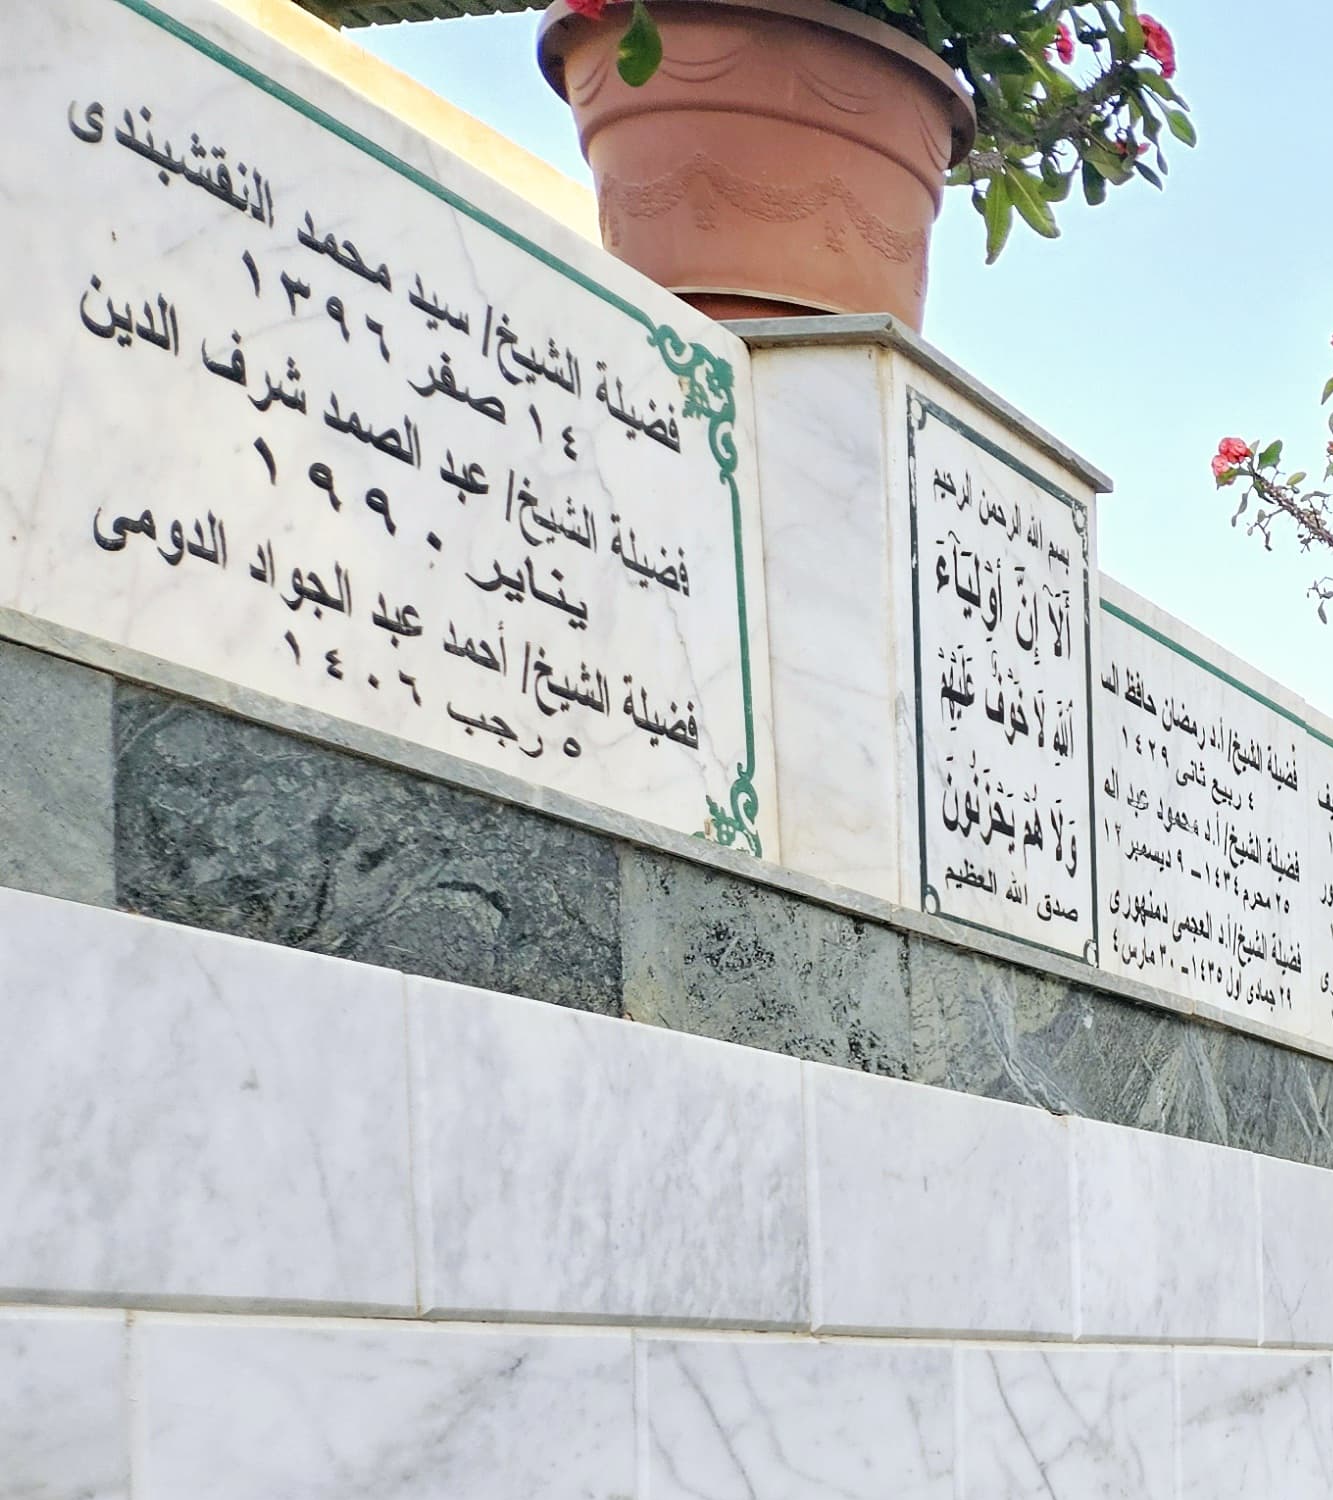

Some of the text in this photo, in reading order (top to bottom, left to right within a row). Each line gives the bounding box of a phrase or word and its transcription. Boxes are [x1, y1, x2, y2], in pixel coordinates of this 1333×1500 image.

[297, 210, 392, 292] محمد
[80, 273, 179, 357] الدين
[409, 273, 470, 335] سيد
[201, 329, 307, 415] شرف
[406, 352, 506, 425] صفر
[324, 391, 422, 470] الصمد
[595, 361, 681, 454] فضيلة
[440, 448, 489, 504] عبد
[933, 468, 1070, 575] بسم الله الرحمن الرحيم
[250, 539, 352, 620] الجواد
[610, 513, 690, 597] فضيلة
[372, 592, 423, 648] عبد
[465, 556, 588, 630] يناير
[443, 619, 507, 676] أحمد
[623, 674, 699, 750] فضيلة
[1125, 667, 1157, 716] حافظ
[447, 702, 544, 758] رجب
[563, 737, 582, 757] ٥
[1161, 697, 1206, 750] رمضان
[1211, 778, 1241, 810] ربيع
[1267, 744, 1298, 791] فضيلة
[1127, 783, 1149, 818] عبد
[1156, 797, 1199, 837] محمود
[1125, 840, 1171, 872] ديسمبر
[1267, 838, 1300, 882] فضيلة
[945, 857, 1079, 922] صدق الله العظيم
[1242, 889, 1271, 911] محرم
[1121, 937, 1156, 969] مارس
[1271, 932, 1301, 975] فضيلة
